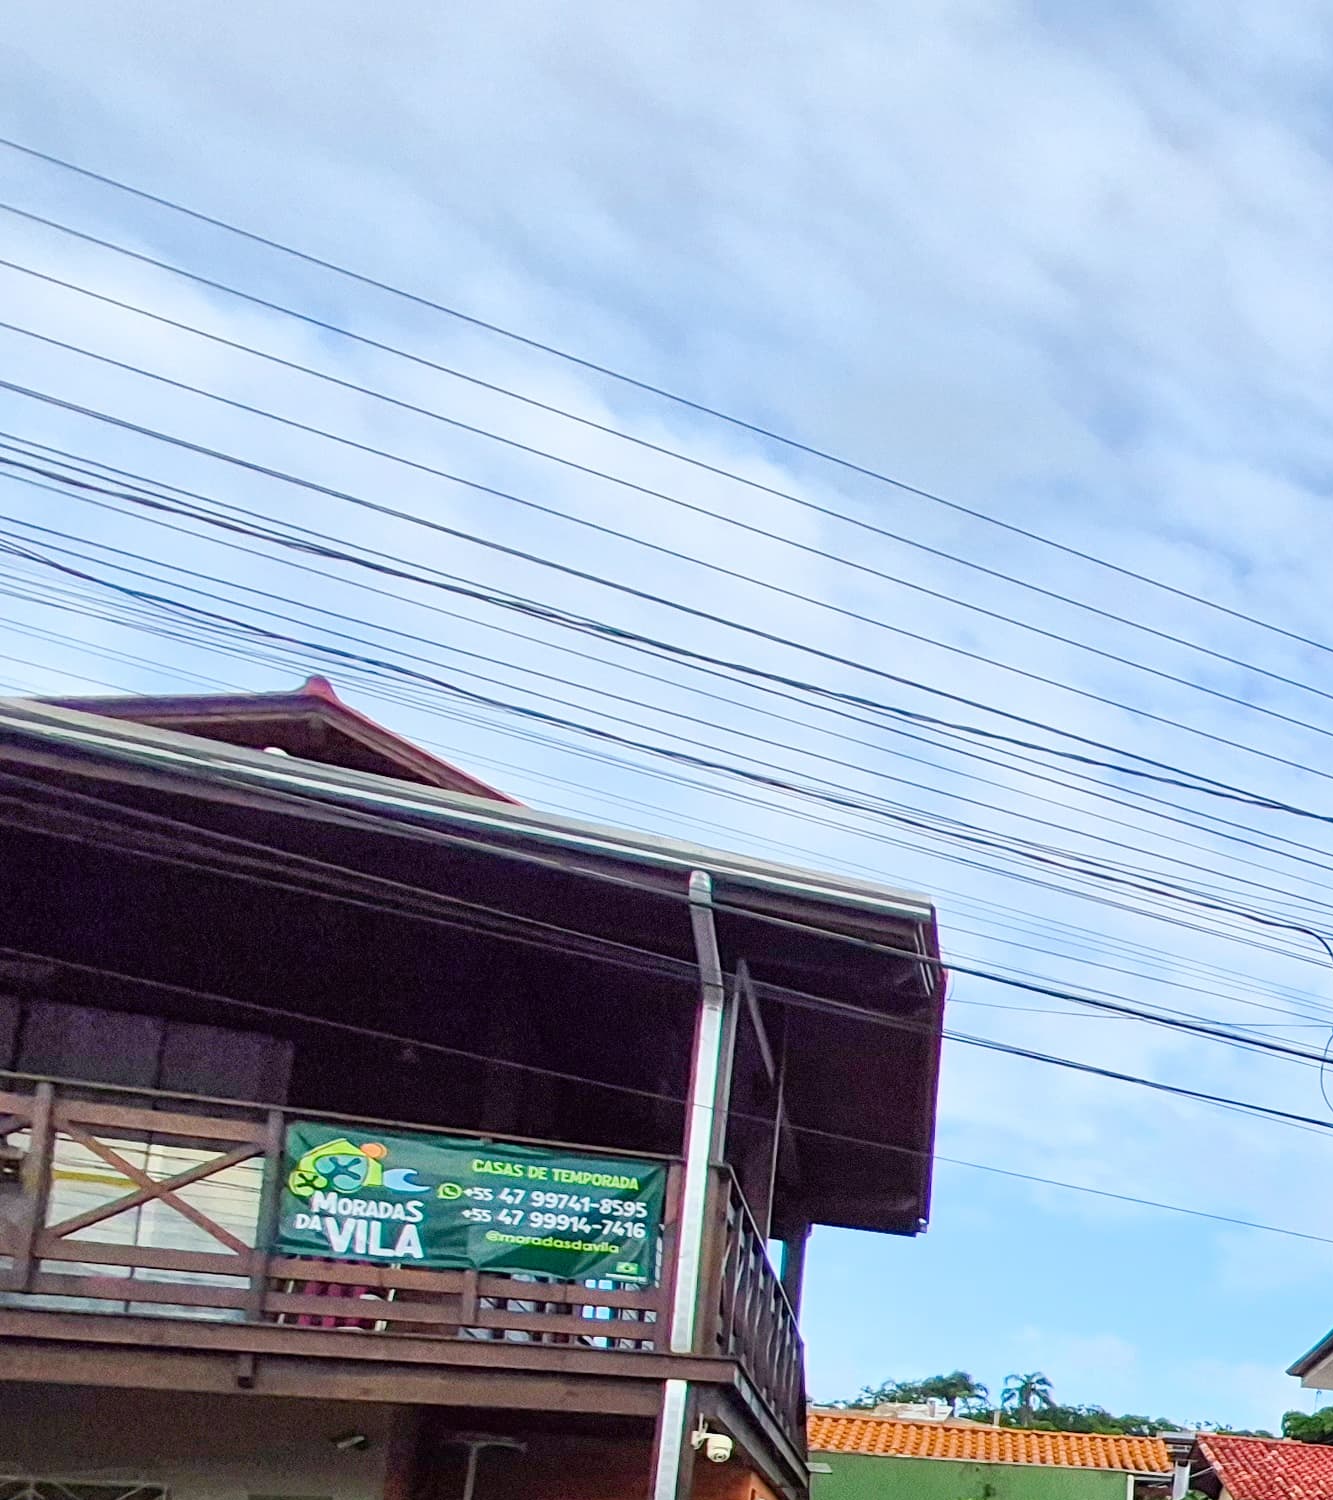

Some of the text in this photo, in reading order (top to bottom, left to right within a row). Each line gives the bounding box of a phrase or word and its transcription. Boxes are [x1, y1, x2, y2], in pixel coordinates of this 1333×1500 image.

[472, 1159, 639, 1191] CASAS DE TEMPORADA
[311, 1191, 424, 1224] MORADAS
[463, 1187, 648, 1219] +55 47 99741-8595
[295, 1213, 424, 1258] DA VILA
[462, 1208, 646, 1239] +55 47 99914-7416
[486, 1229, 620, 1254] @moradasdavila
